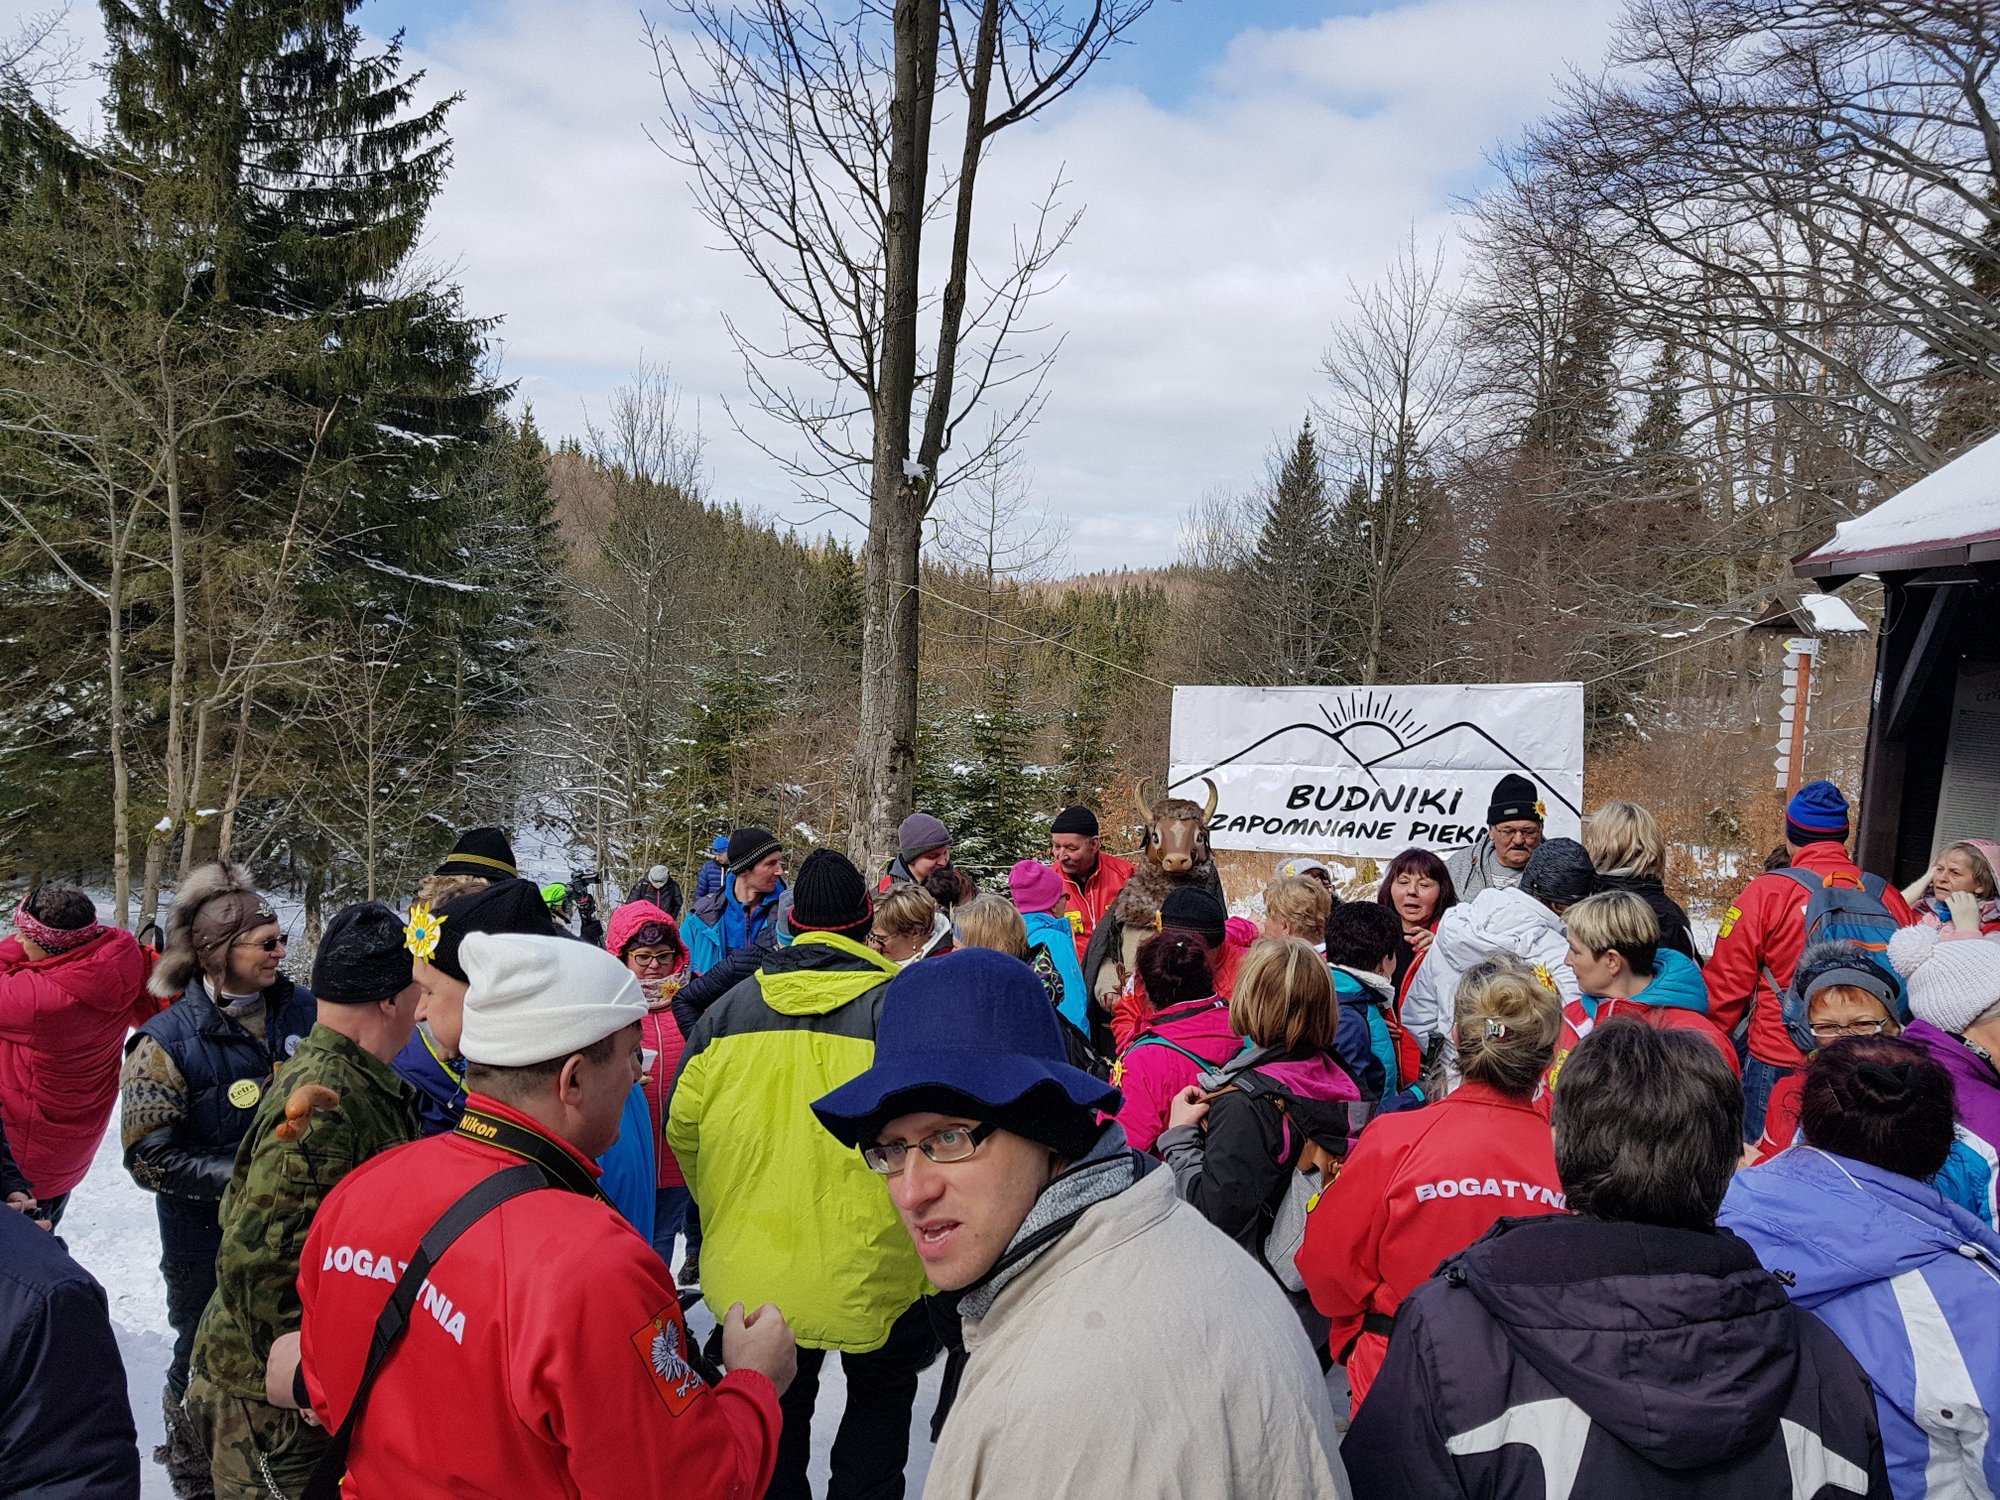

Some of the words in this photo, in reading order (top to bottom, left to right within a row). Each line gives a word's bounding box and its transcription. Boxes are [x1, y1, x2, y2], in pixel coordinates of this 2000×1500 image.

[1286, 784, 1463, 815] BUDNIKI
[1208, 814, 1397, 840] ZAPOMNIANE
[459, 1115, 498, 1139] Nikon
[322, 1246, 466, 1345] BOGAYNIA
